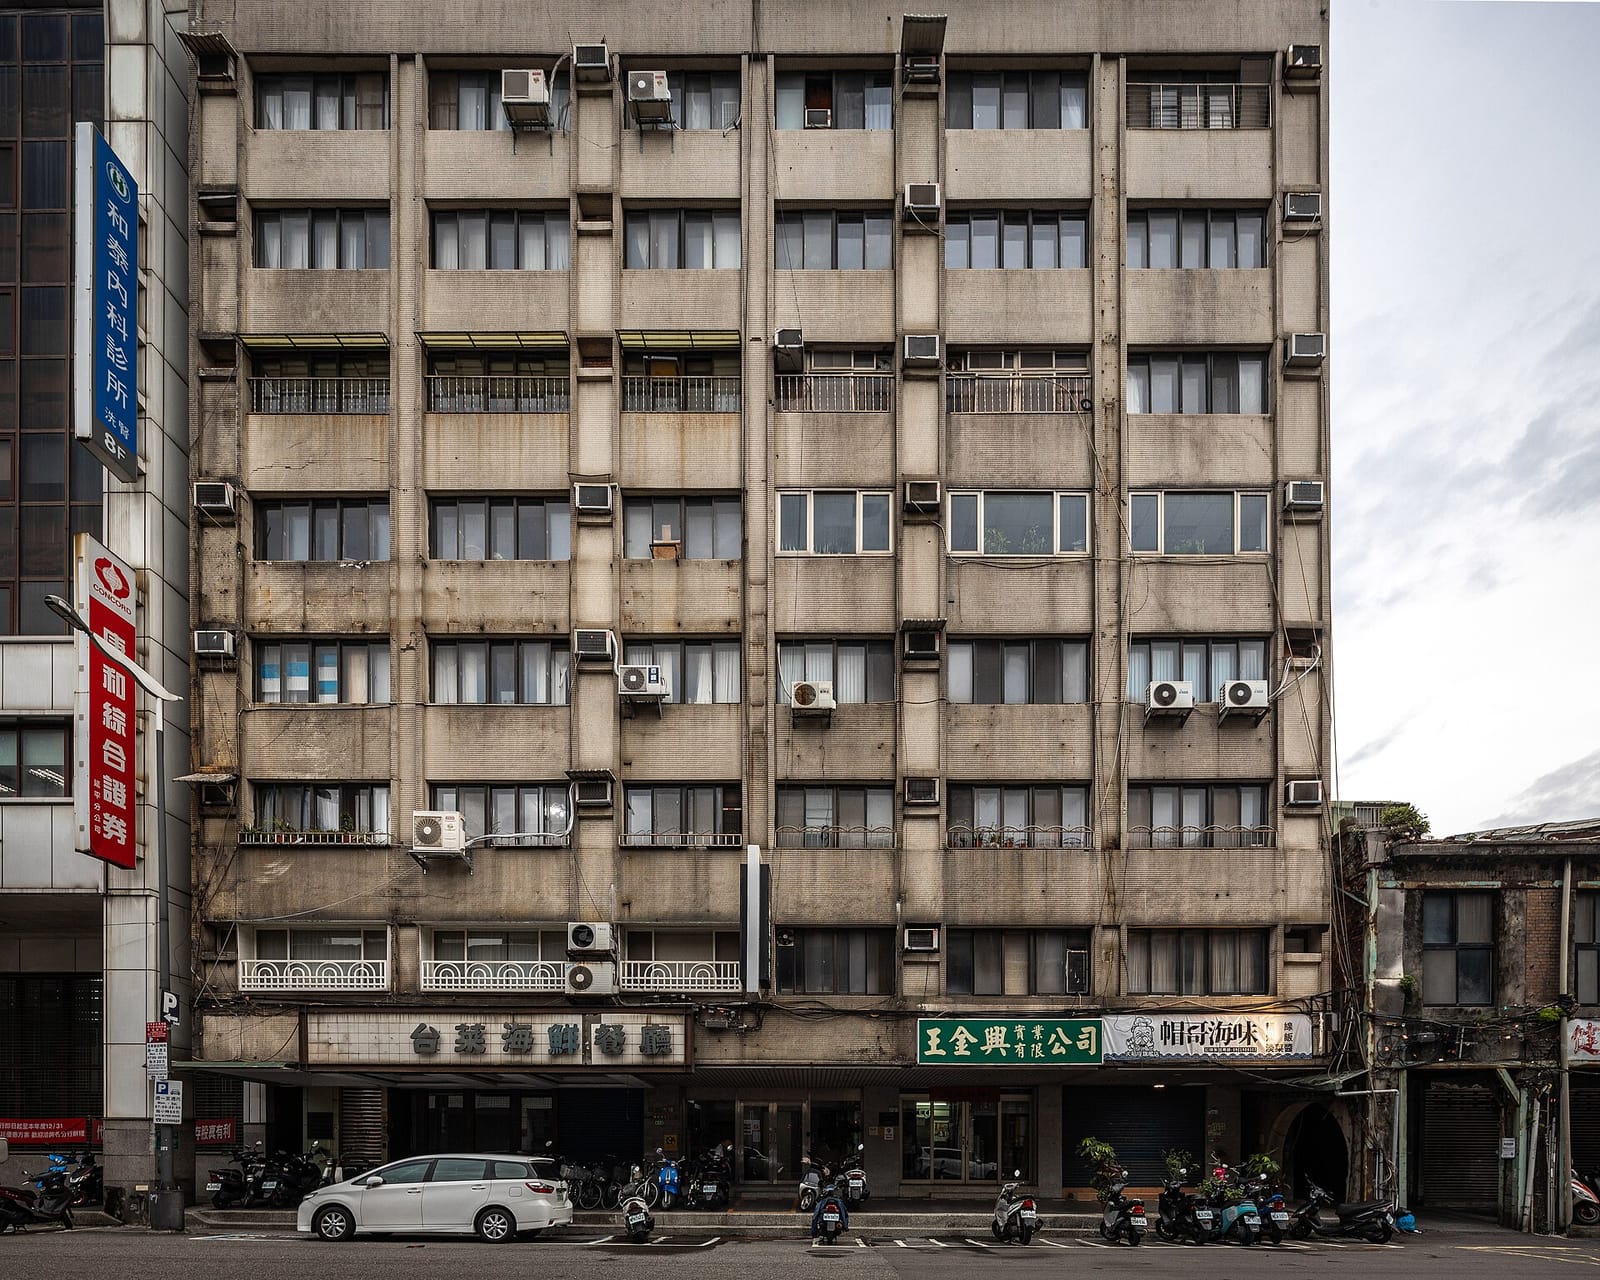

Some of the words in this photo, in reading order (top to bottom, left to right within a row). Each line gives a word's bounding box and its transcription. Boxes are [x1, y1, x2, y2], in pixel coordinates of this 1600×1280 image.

[106, 199, 129, 409] 和泰內科診所
[104, 432, 127, 460] 8F
[93, 583, 132, 616] CONCORD
[163, 991, 178, 1013] P
[410, 1022, 673, 1056] 台菜海鮮餐廳
[1160, 1020, 1258, 1046] 帽哥海味
[158, 1083, 167, 1093] P
